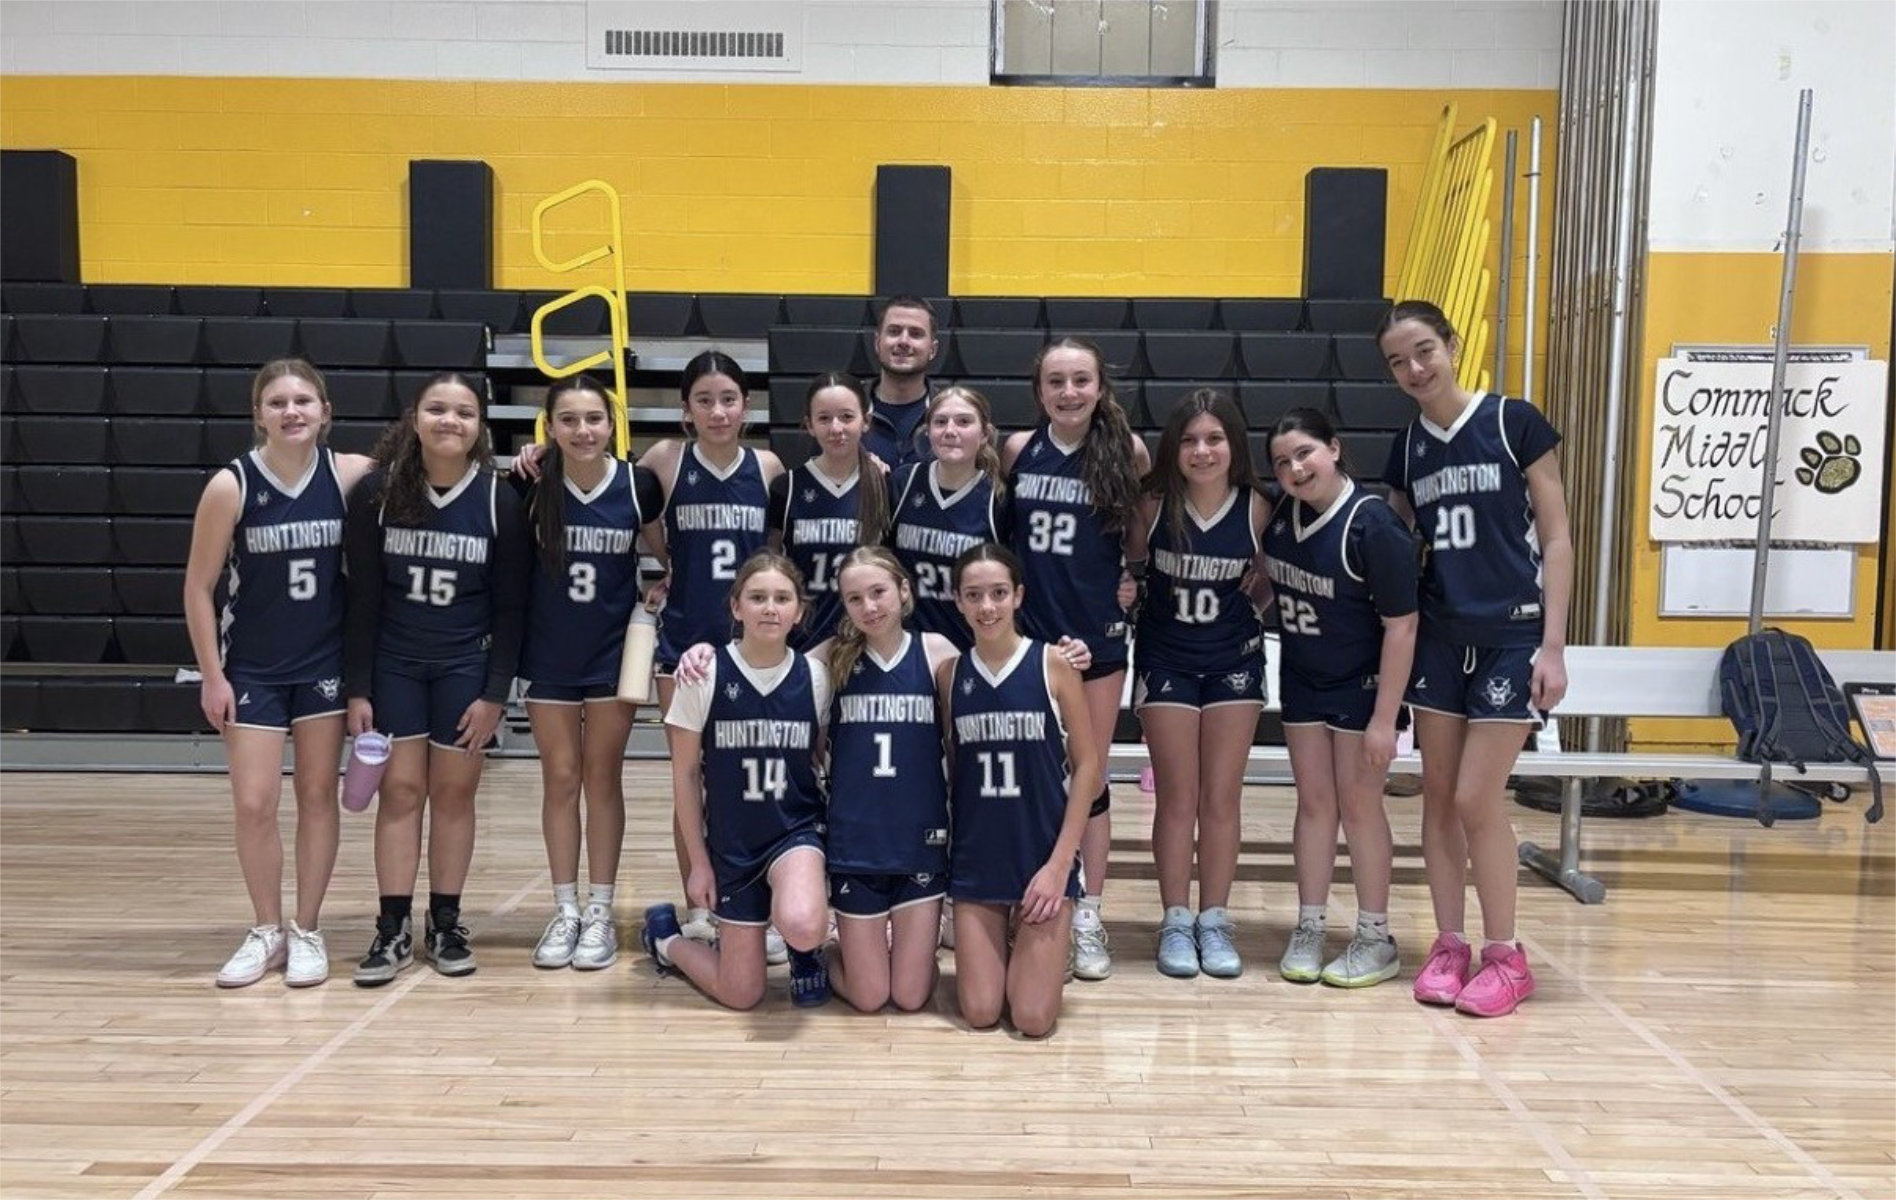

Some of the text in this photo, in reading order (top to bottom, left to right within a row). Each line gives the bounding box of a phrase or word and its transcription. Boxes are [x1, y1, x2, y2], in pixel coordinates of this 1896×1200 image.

[1659, 424, 1781, 469] Middl
[1412, 463, 1501, 508] HUNTINGTON
[1653, 474, 1785, 519] Schoo
[676, 503, 765, 532] HUNTINGTON
[793, 518, 858, 545] HUNTING
[1028, 510, 1077, 555] 32
[1434, 504, 1475, 551] 20
[383, 527, 488, 564] HUNTINGTON
[565, 525, 634, 554] TINGTON
[711, 539, 736, 580] 2
[287, 558, 316, 601] 5
[406, 565, 458, 607] 15
[568, 562, 596, 603] 3
[915, 561, 956, 600] 21
[1174, 586, 1220, 624] 10
[1278, 593, 1322, 636] 22
[839, 693, 935, 724] HUNTINGTON
[955, 710, 1046, 745] HUNTINGTON
[715, 718, 811, 750] HUNTINGTON
[872, 732, 897, 778] 1
[977, 751, 1021, 798] 11
[741, 757, 789, 802] 14
